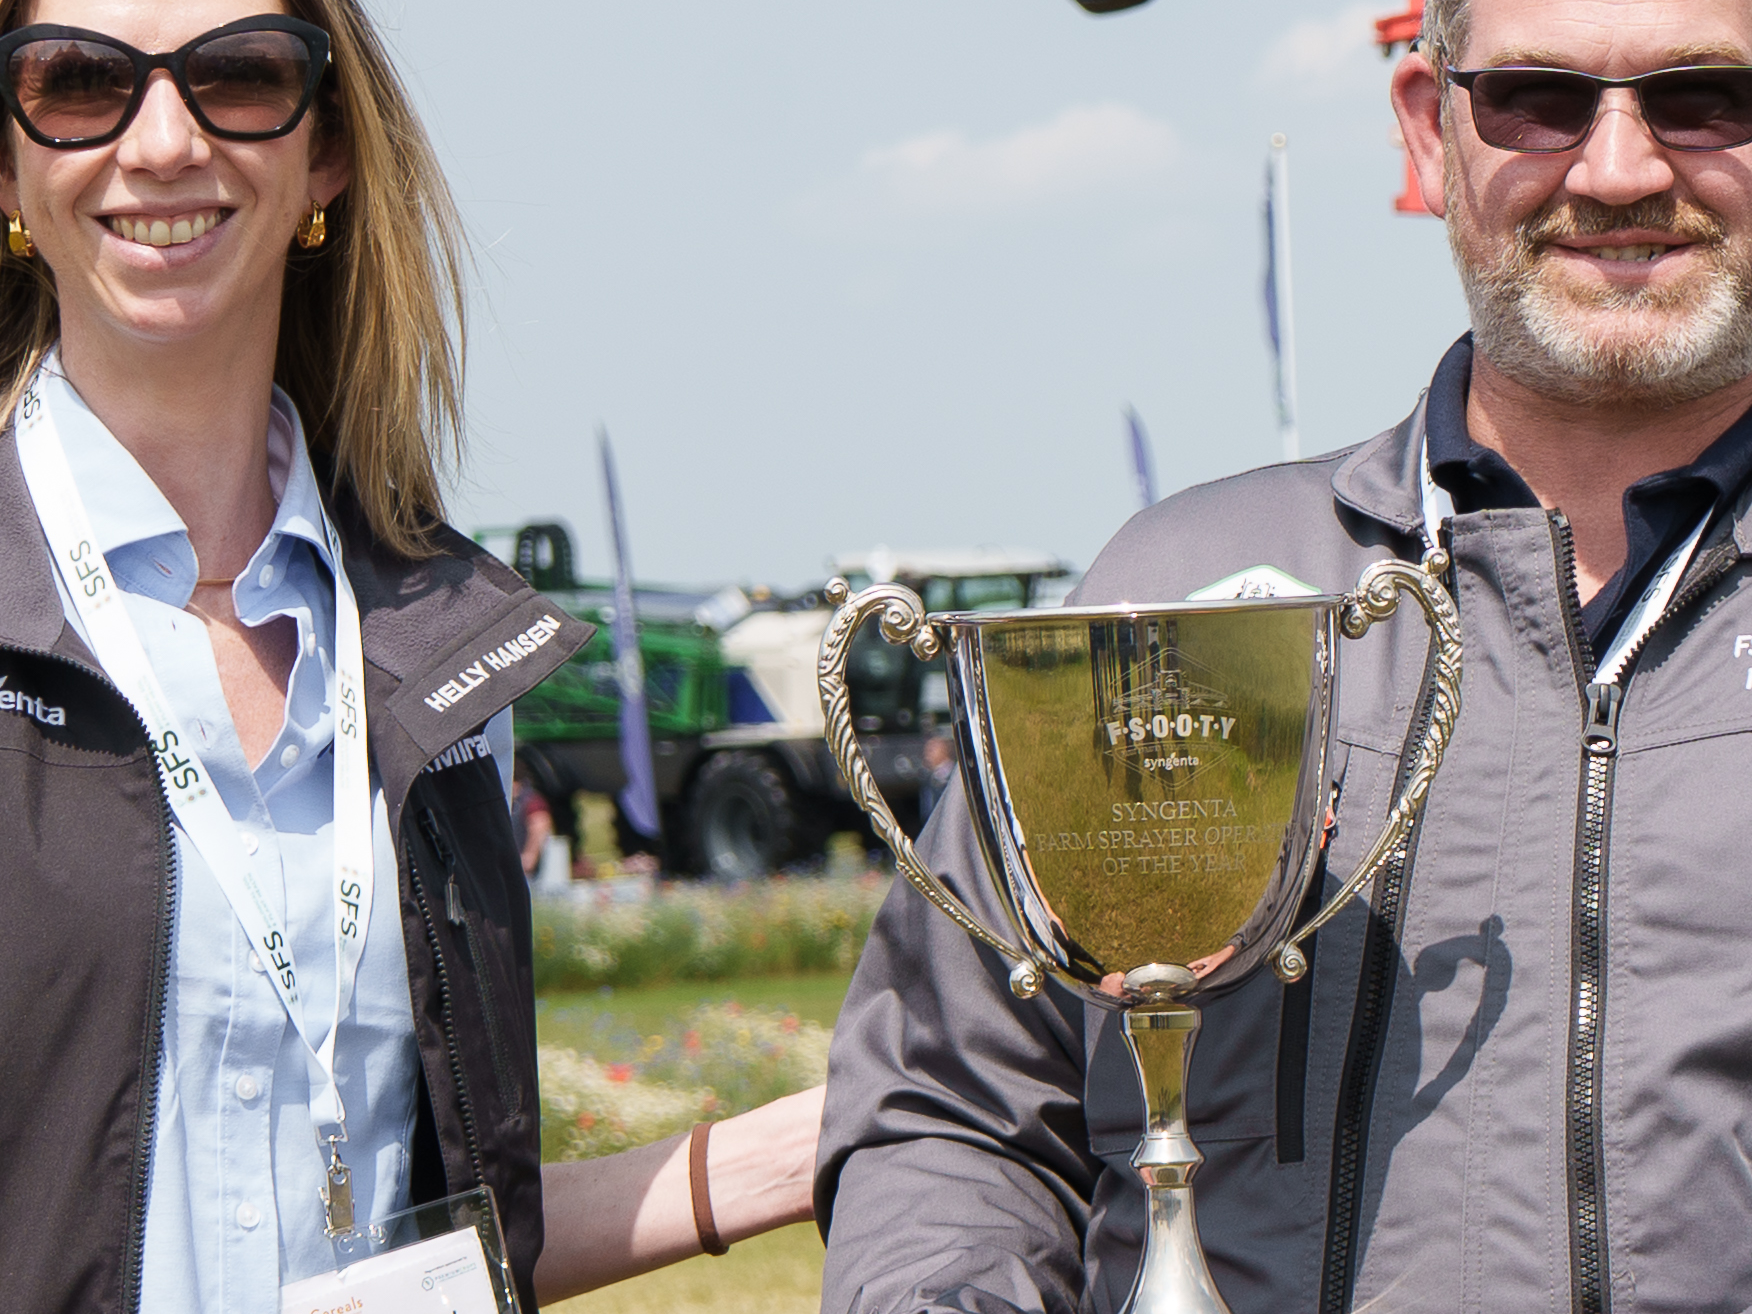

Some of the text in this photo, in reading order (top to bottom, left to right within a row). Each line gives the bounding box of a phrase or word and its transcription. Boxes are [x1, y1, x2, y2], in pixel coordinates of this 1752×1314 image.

[69, 540, 106, 597] SFS
[424, 614, 562, 713] HELLY HANSEN
[340, 681, 357, 739] SFS
[155, 730, 200, 790] SFS
[1143, 753, 1200, 771] syngenta
[1112, 799, 1238, 823] SYNGENTA
[1036, 832, 1094, 853] FARM
[1098, 827, 1199, 850] SPRAYER
[1102, 853, 1246, 877] OF THE YEAR
[340, 879, 361, 940] SFS
[263, 931, 296, 990] SFS
